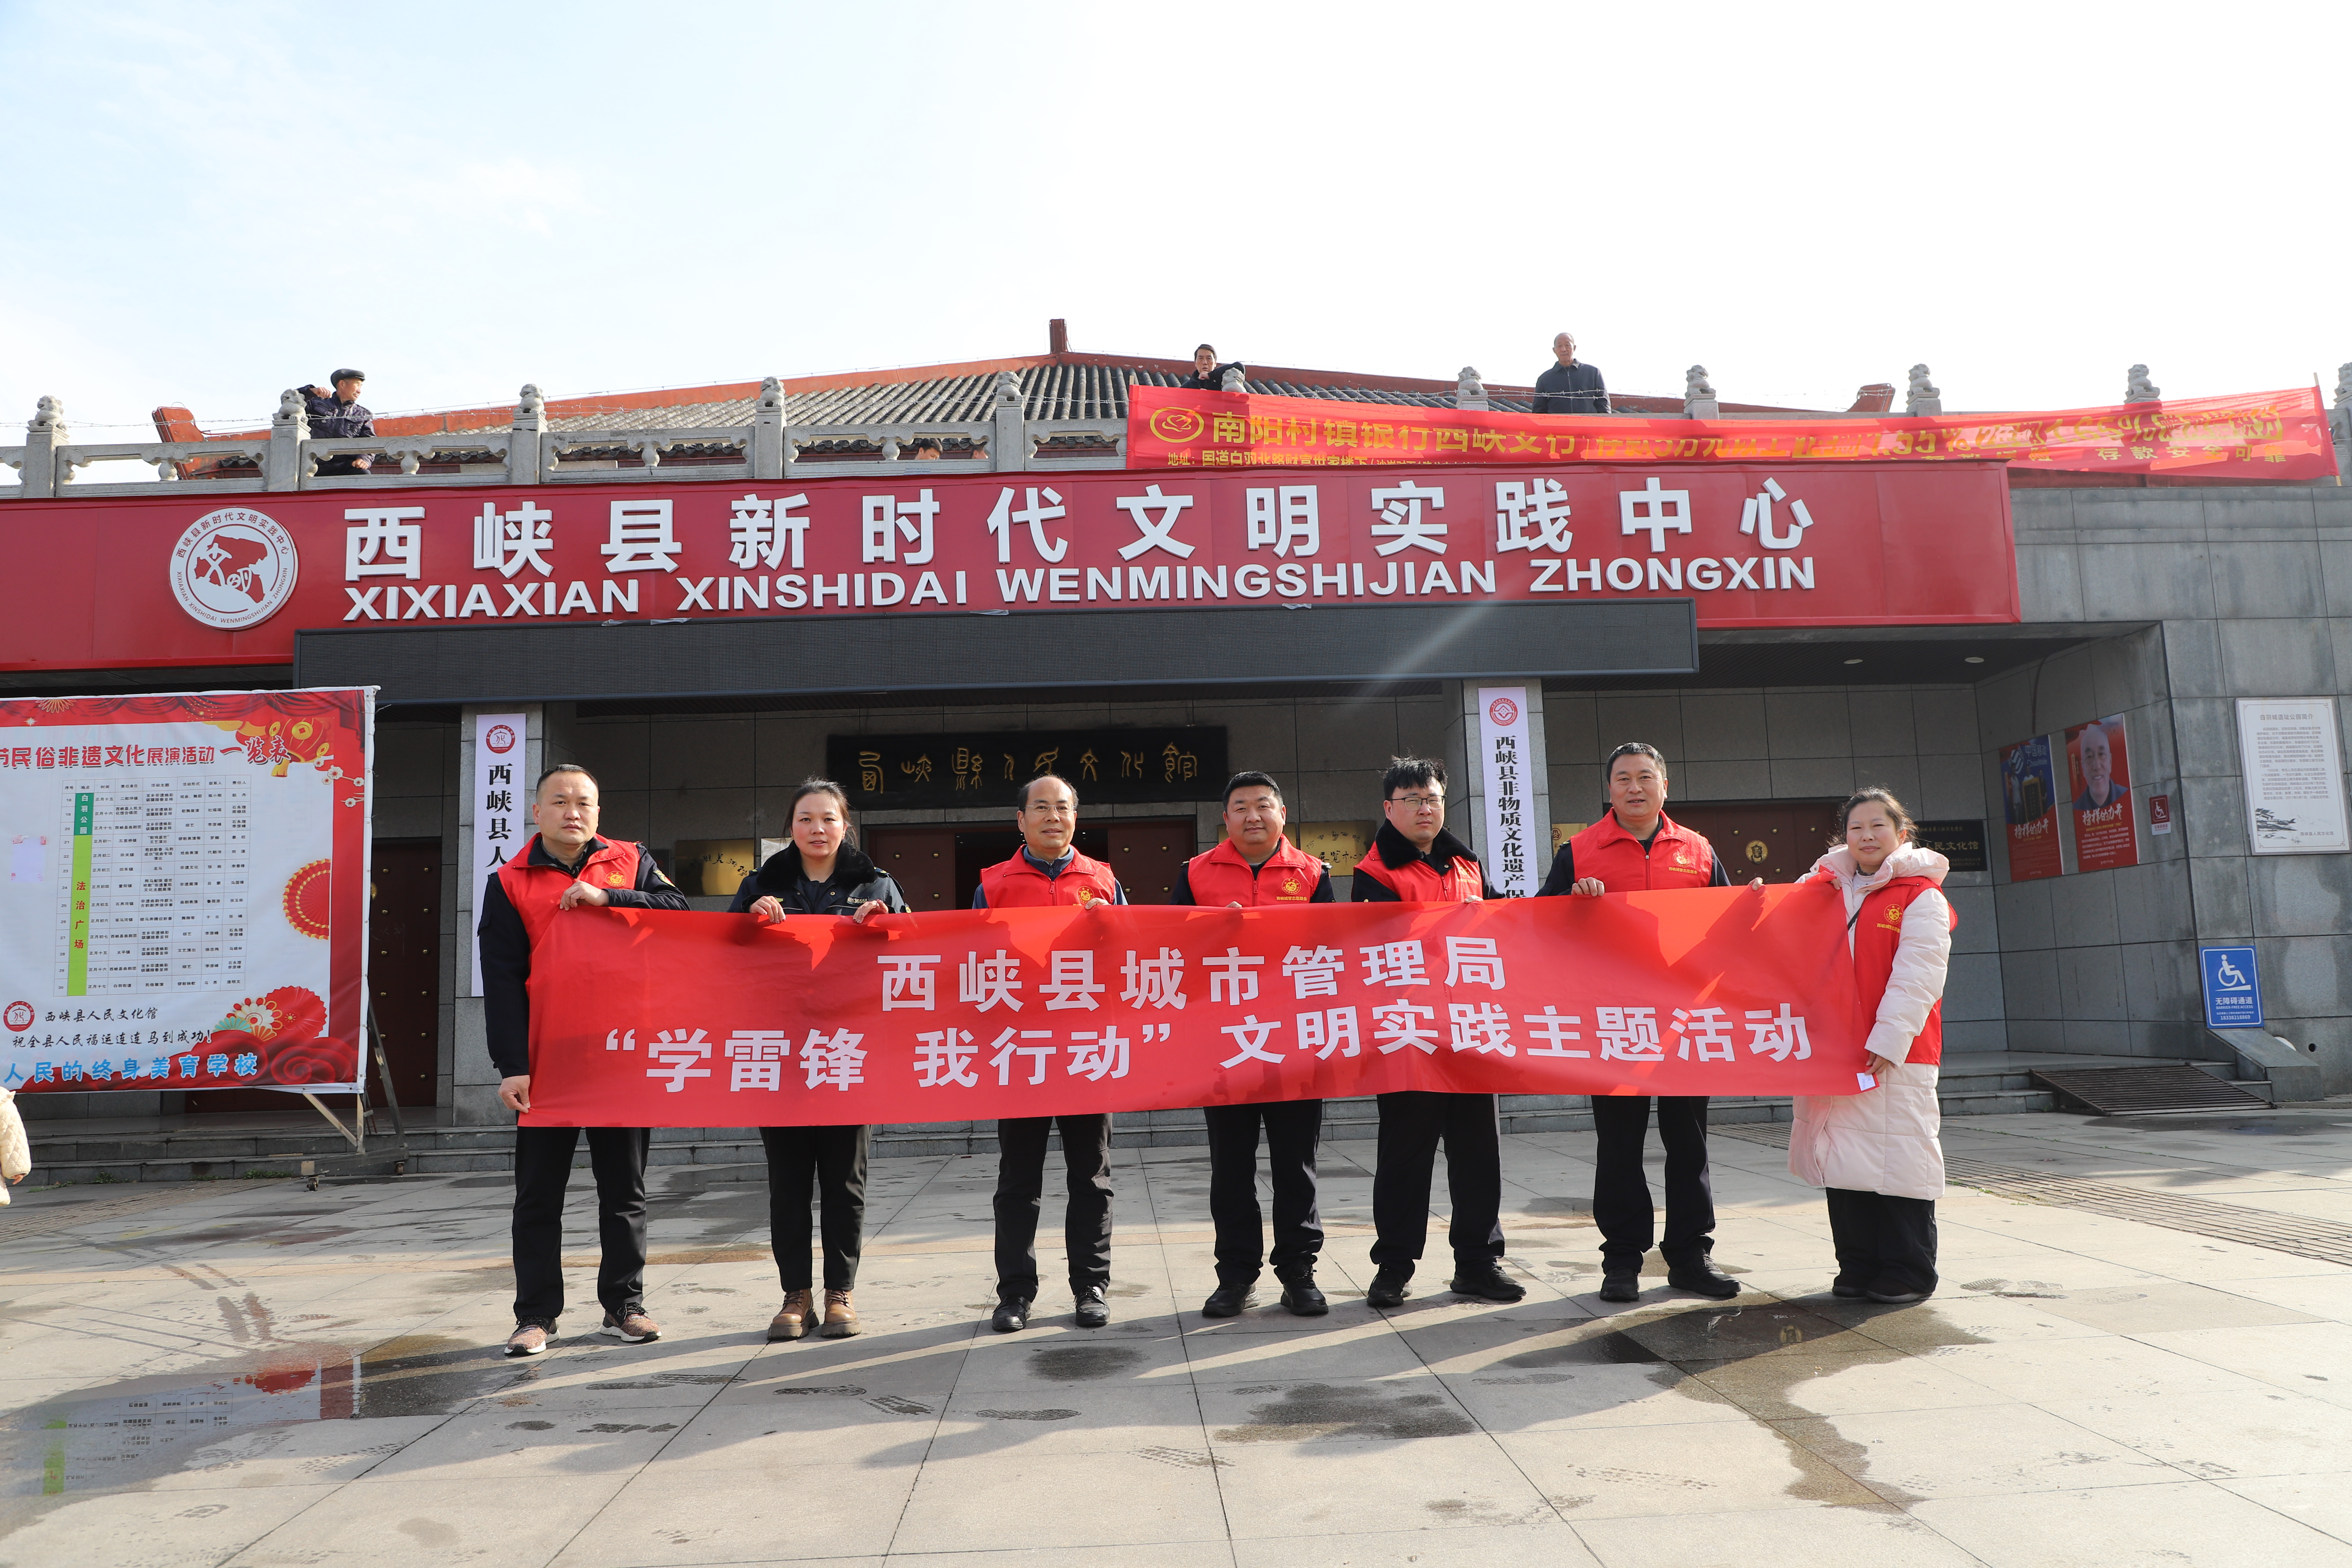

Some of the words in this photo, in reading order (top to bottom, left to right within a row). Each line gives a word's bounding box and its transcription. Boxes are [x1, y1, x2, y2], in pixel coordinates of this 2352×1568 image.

[2096, 443, 2287, 463] 存款安全可靠
[176, 512, 290, 559] 西峡县新时代文明实践中心
[344, 478, 1815, 582] 西峡县新时代文明实践中心
[177, 571, 190, 602] XIXIAXIAN
[188, 602, 217, 622] XINSHIDAI
[220, 600, 273, 624] WENMINGSHIJIAN
[272, 568, 288, 599] ZHONGXIN
[343, 577, 639, 622] XIXIAXIAN
[676, 570, 969, 612] XINSHIDAI
[995, 560, 1496, 604] WENMINGSHIJIAN
[1529, 556, 1815, 592] ZHONGXIN
[219, 736, 292, 765] 一览表
[2025, 744, 2047, 757] 中国移动
[80, 795, 89, 834] 白羽公园
[485, 763, 513, 878] 西峡县人
[74, 882, 86, 948] 法治广场
[877, 934, 1507, 1014] 西峡县城市管理局
[45, 1007, 158, 1023] 西峡县人民文化馆
[2215, 997, 2253, 1005] 无障碍通道
[12, 1031, 141, 1049] 祝全县人民福运连连
[603, 1026, 869, 1094] “学雷锋
[914, 1020, 1173, 1089] 我行动”
[1219, 998, 1814, 1066] 文明实践主题活动
[3, 1052, 259, 1084] 人民的终身美育学校
